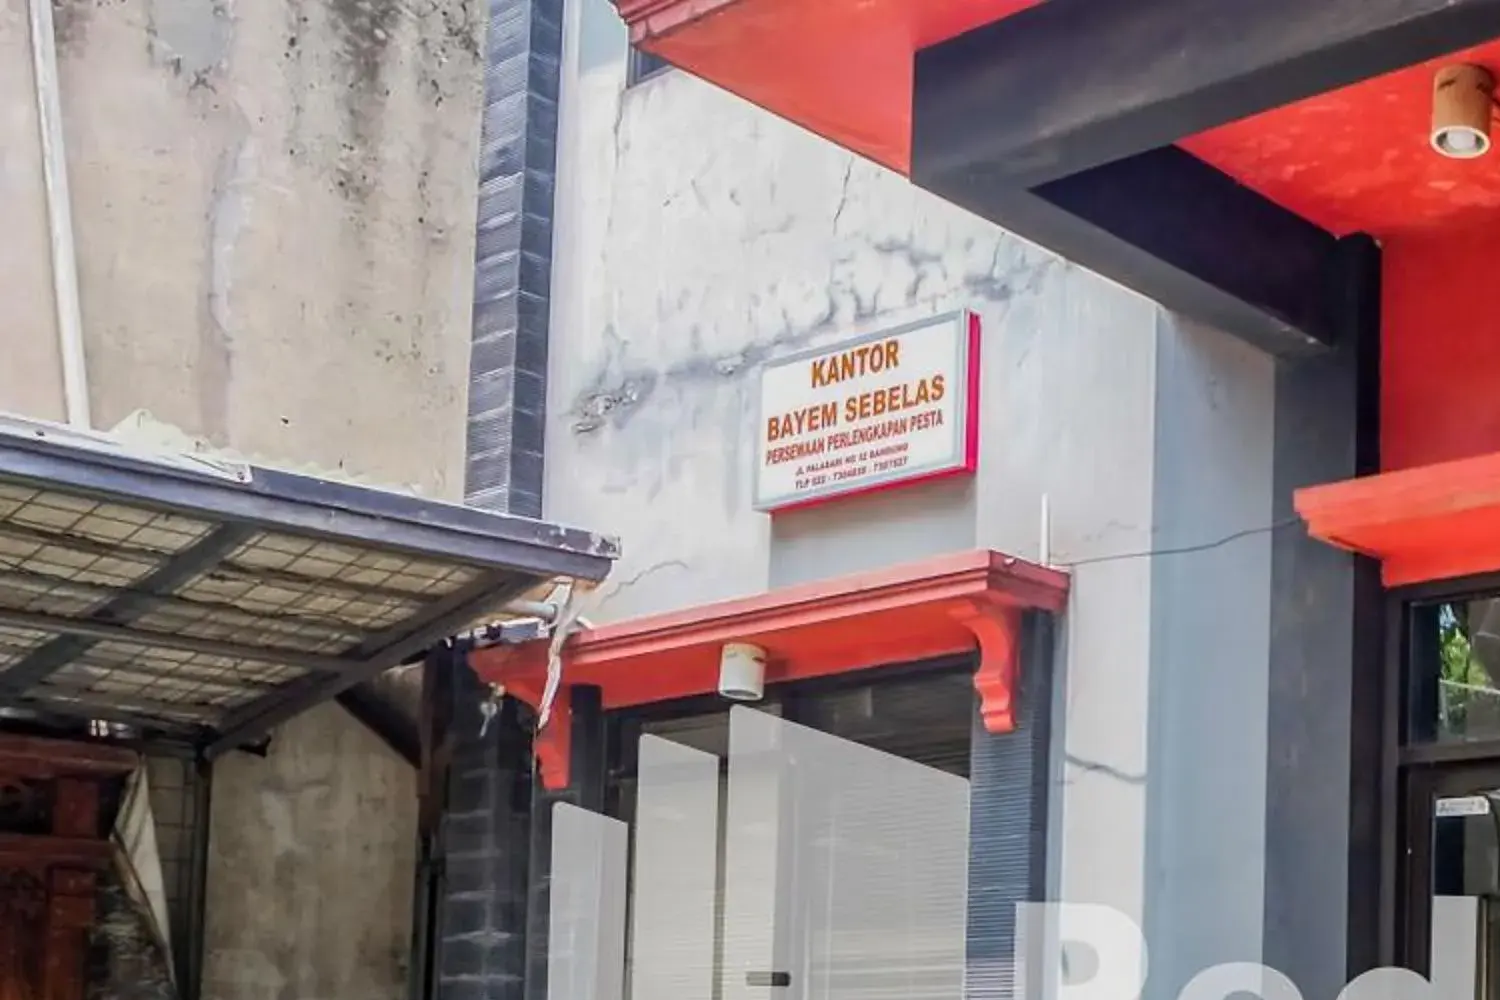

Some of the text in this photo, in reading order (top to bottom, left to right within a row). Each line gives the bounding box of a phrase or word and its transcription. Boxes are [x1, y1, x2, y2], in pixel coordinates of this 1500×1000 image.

[811, 339, 900, 388] KANTOR
[767, 375, 945, 442] BAYEM SEBELAS
[827, 419, 907, 452] PERLENGKAPAN
[909, 409, 943, 432] PESTA
